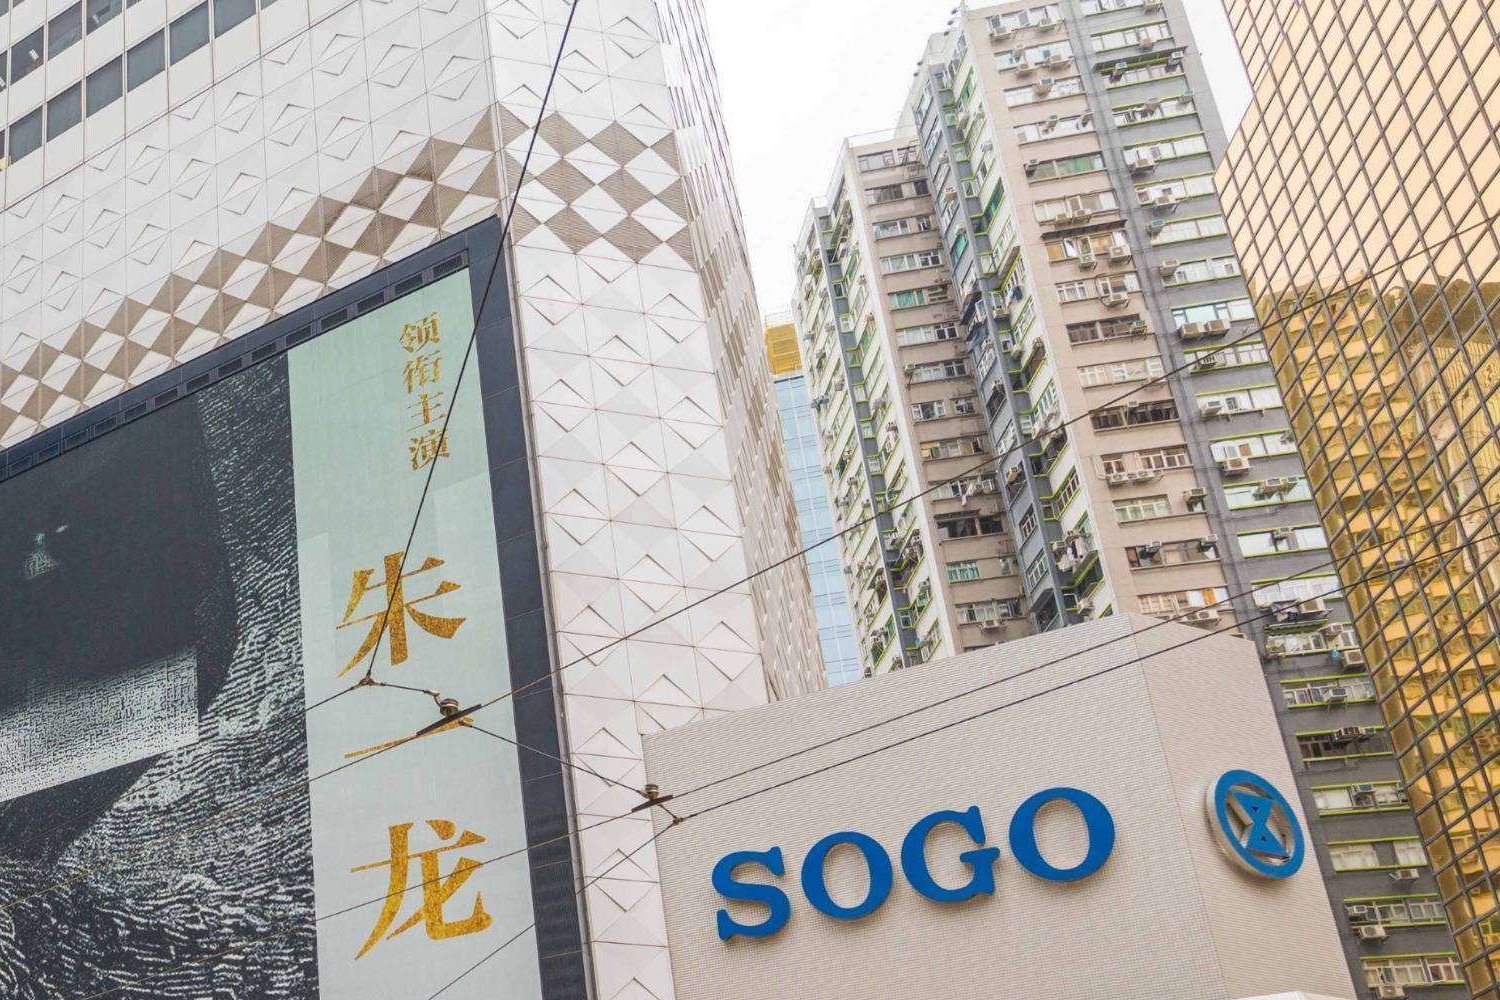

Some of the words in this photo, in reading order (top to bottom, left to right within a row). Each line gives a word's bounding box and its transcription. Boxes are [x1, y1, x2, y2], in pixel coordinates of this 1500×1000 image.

[399, 312, 451, 471] 领衔主演
[336, 551, 493, 961] 朱一龙
[712, 786, 1116, 942] SOGO
